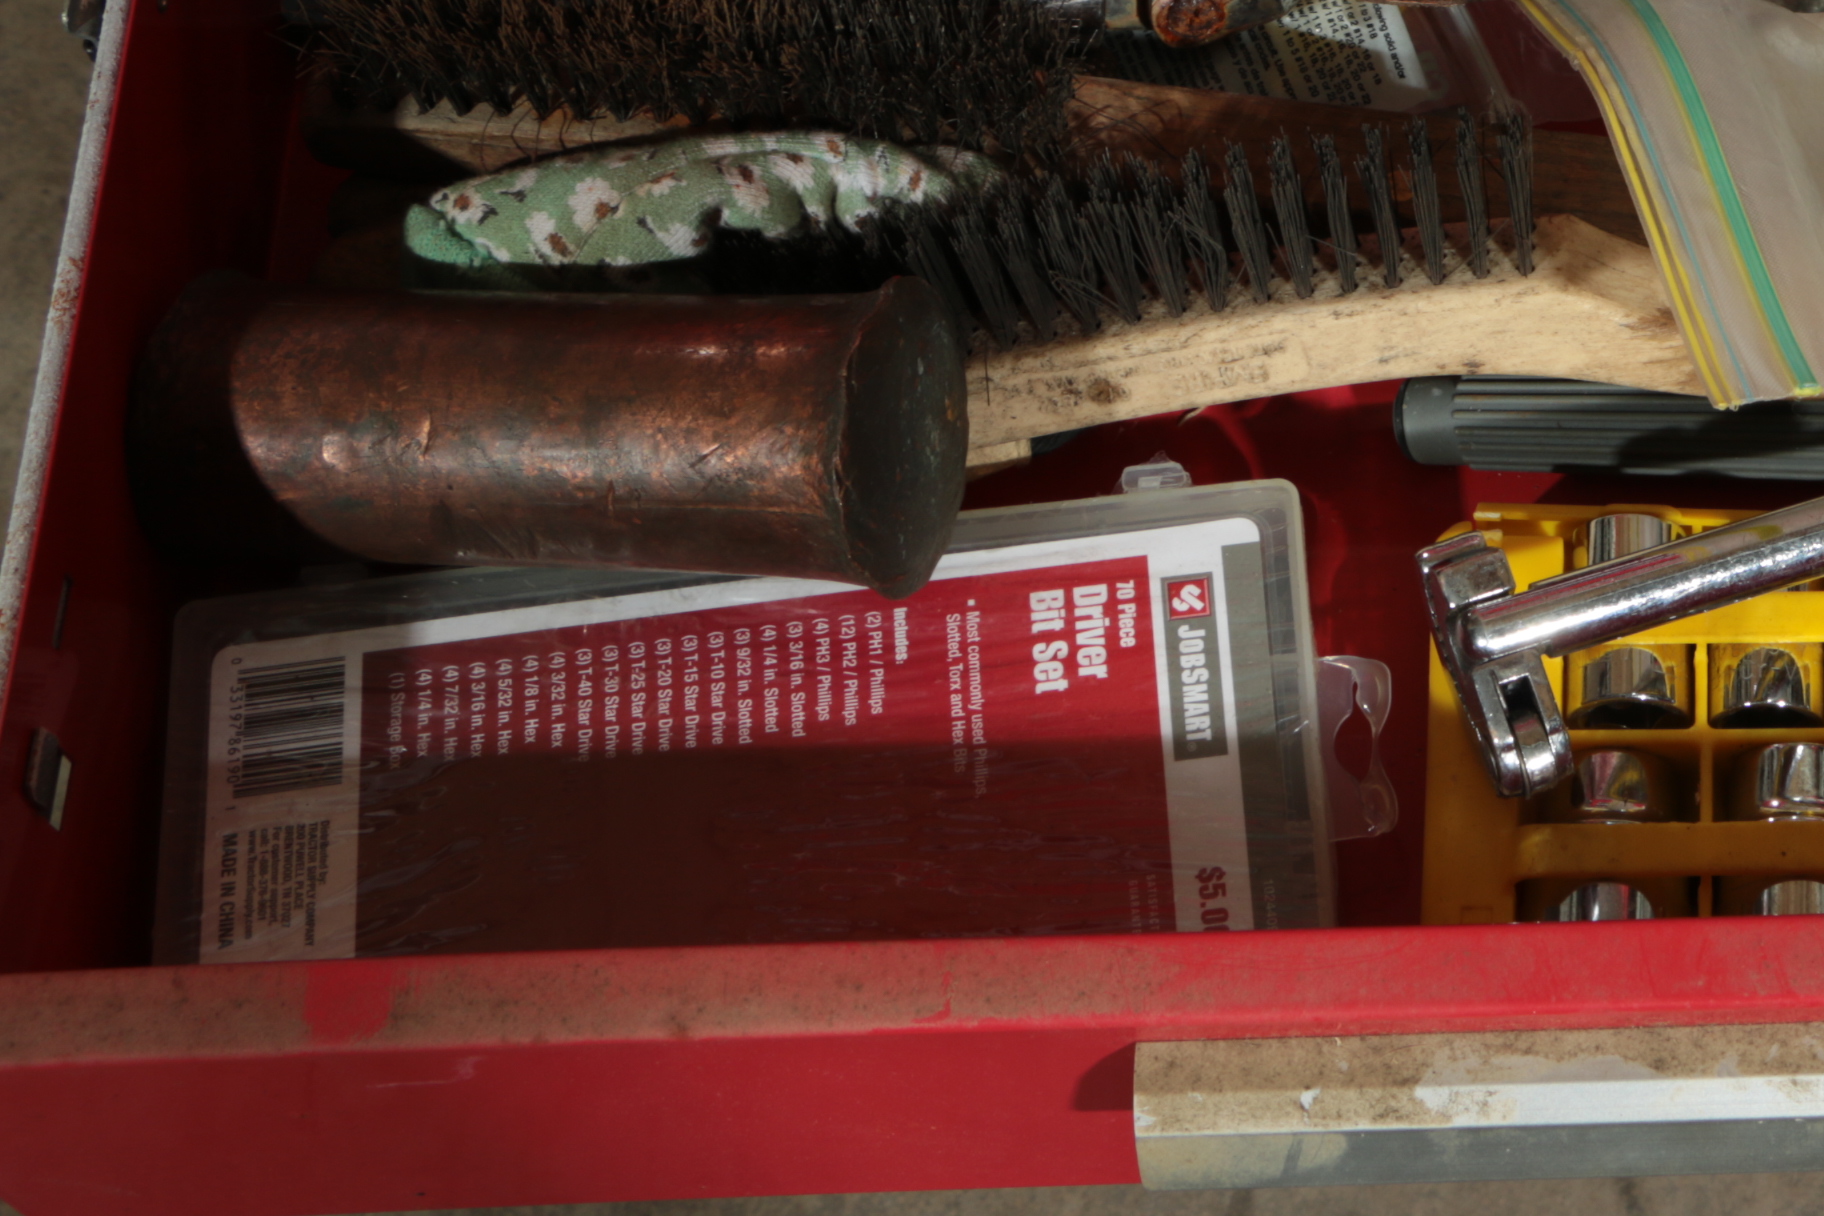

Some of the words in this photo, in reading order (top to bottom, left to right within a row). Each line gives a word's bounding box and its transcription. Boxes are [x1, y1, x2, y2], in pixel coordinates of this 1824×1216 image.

[1389, 51, 1408, 80] and/or
[1114, 579, 1135, 600] 70
[863, 610, 881, 629] (2)
[1026, 588, 1067, 634] Bit
[732, 627, 751, 645] (3)
[758, 624, 776, 642] (4)
[785, 620, 802, 639] (3)
[810, 617, 828, 636] (4)
[837, 613, 856, 640] (12)
[889, 607, 912, 664] Includes:
[941, 612, 963, 662] Slotted,
[962, 610, 981, 642] Most
[1068, 582, 1115, 680] Driver
[1115, 602, 1140, 648] Piece
[601, 644, 619, 662] (3)
[627, 641, 646, 658] (3)
[654, 637, 672, 655] (3)
[680, 634, 698, 651] (3)
[706, 631, 724, 648] (3)
[812, 636, 831, 663] PH3
[864, 630, 883, 655] PH1
[495, 658, 513, 675] (4)
[521, 654, 539, 672] (4)
[547, 651, 565, 669] (4)
[574, 648, 592, 665] (3)
[681, 653, 699, 682] T-15
[707, 649, 725, 679] T-10
[734, 646, 753, 677] 9/32
[759, 643, 778, 666] 1/4
[785, 639, 804, 670] 3/16
[839, 641, 858, 667] PH2
[1029, 639, 1071, 695] Set
[388, 671, 406, 689] (1)
[414, 668, 433, 686] (4)
[441, 665, 459, 682] (4)
[468, 661, 486, 679] (4)
[576, 666, 593, 696] T-40
[602, 663, 620, 693] T-30
[629, 659, 647, 689] T-25
[655, 656, 673, 686] T-20
[762, 668, 779, 685] in.
[788, 672, 805, 689] in.
[946, 663, 964, 690] Torx
[960, 645, 985, 710] commonly
[469, 681, 487, 711] 3/16
[496, 677, 514, 707] 5/32
[522, 674, 540, 696] 1/8
[548, 671, 567, 701] 3/32
[681, 684, 700, 711] Star
[707, 681, 726, 708] Star
[736, 679, 753, 696] in.
[812, 673, 835, 721] Phillips
[864, 667, 887, 715] Phillips
[415, 688, 433, 710] 1/4
[442, 684, 461, 714] 7/32
[521, 698, 539, 716] in.
[548, 703, 566, 720] in.
[576, 698, 594, 725] Star
[602, 695, 621, 722] Star
[629, 691, 647, 718] Star
[655, 688, 674, 715] Star
[759, 686, 782, 733] Slotted
[838, 678, 861, 726] Phillips
[948, 692, 966, 718] and
[383, 691, 408, 744] Storage
[415, 712, 433, 729] in.
[442, 716, 460, 733] in.
[469, 713, 487, 730] in.
[495, 709, 514, 726] in.
[733, 698, 756, 744] Slotted
[786, 691, 809, 737] Slotted
[495, 729, 513, 754] Hex
[521, 718, 539, 744] Hex
[548, 722, 566, 748] Hex
[603, 724, 621, 759] Drive
[629, 721, 648, 755] Drive
[655, 717, 674, 752] Drive
[681, 714, 700, 748] Drive
[708, 711, 726, 745] Drive
[949, 720, 967, 745] Hex
[969, 713, 987, 744] used
[415, 732, 433, 757] Hex
[442, 736, 460, 761] Hex
[468, 732, 487, 758] Hex
[576, 728, 594, 762] Drive
[219, 831, 239, 878] MADE
[219, 881, 236, 897] IN
[215, 900, 235, 951] CHINA
